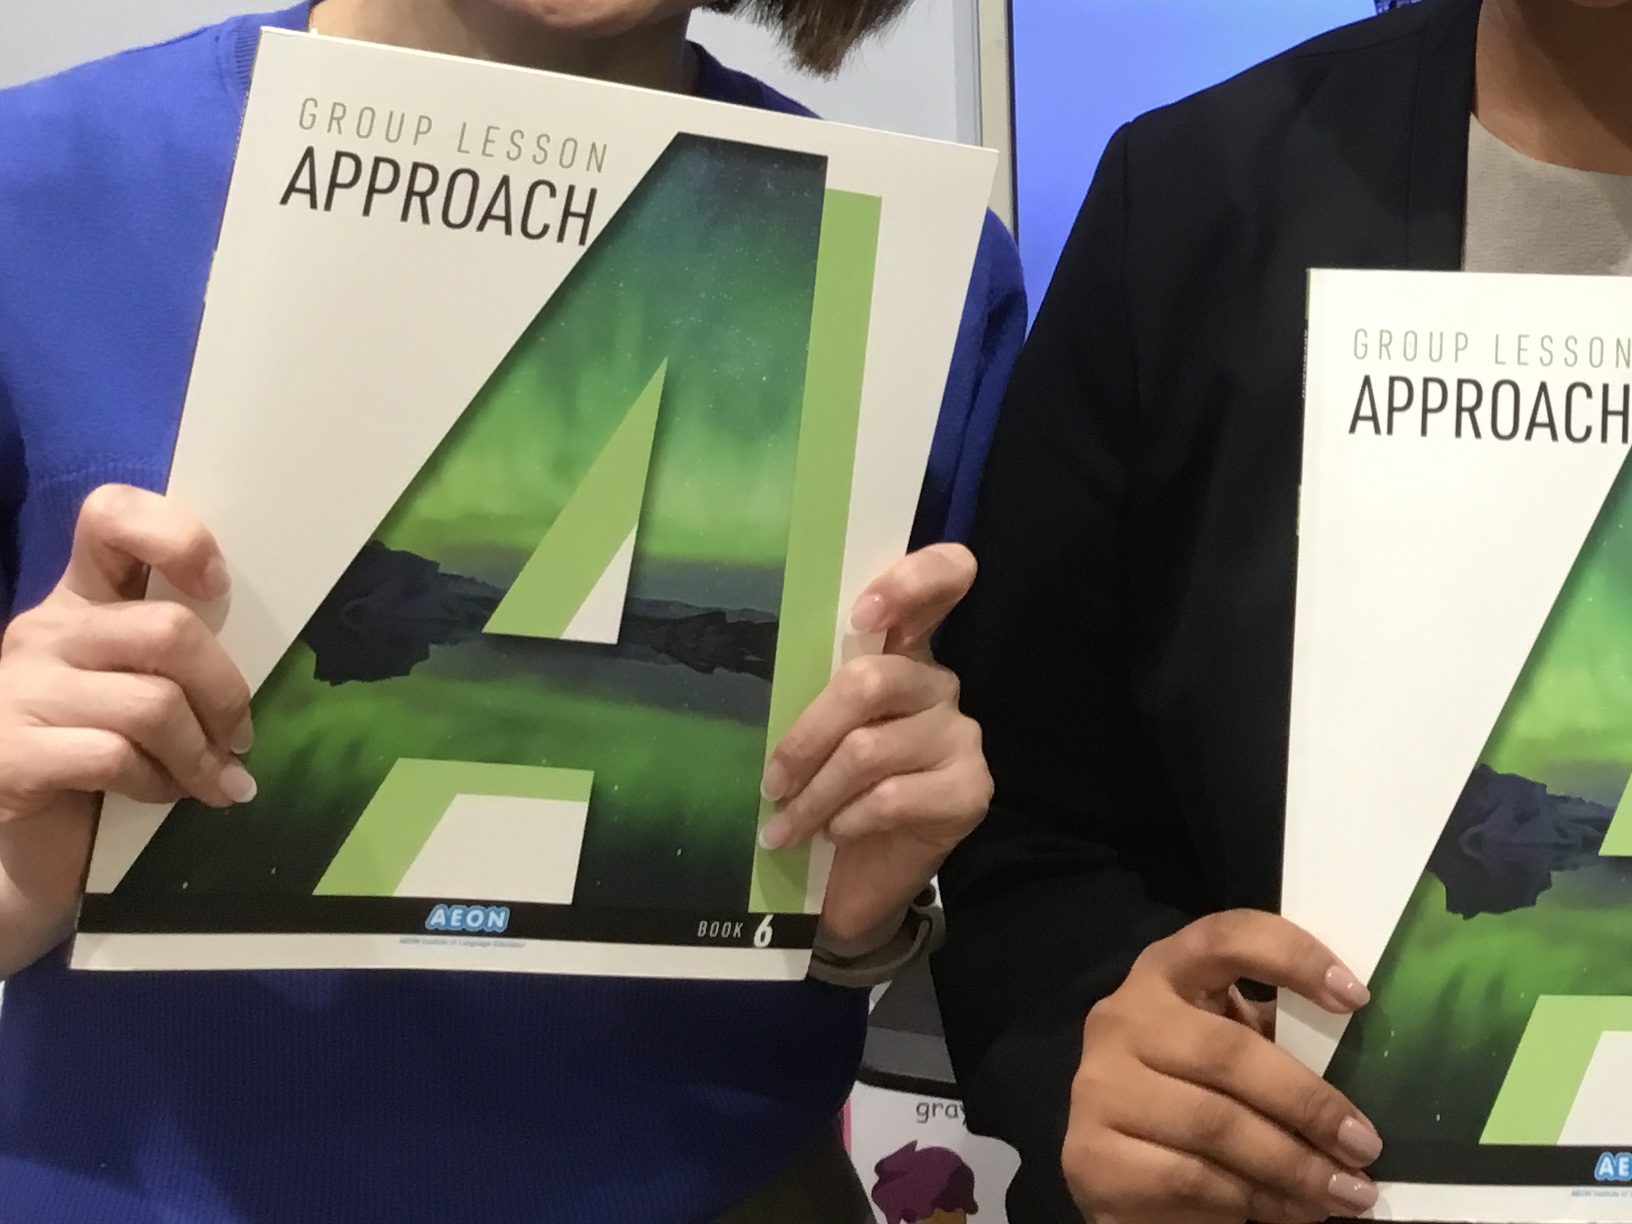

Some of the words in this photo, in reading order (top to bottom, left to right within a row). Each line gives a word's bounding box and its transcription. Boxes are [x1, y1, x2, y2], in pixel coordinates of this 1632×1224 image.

[299, 97, 432, 146] GROUP
[457, 122, 607, 173] LESSON
[279, 145, 598, 247] APPROACH
[1353, 328, 1469, 363] GROUP
[1494, 334, 1632, 369] LESSON
[1349, 374, 1631, 444] APPROACH
[427, 906, 508, 930] AEON
[697, 920, 744, 938] BOOK
[753, 914, 775, 948] 6
